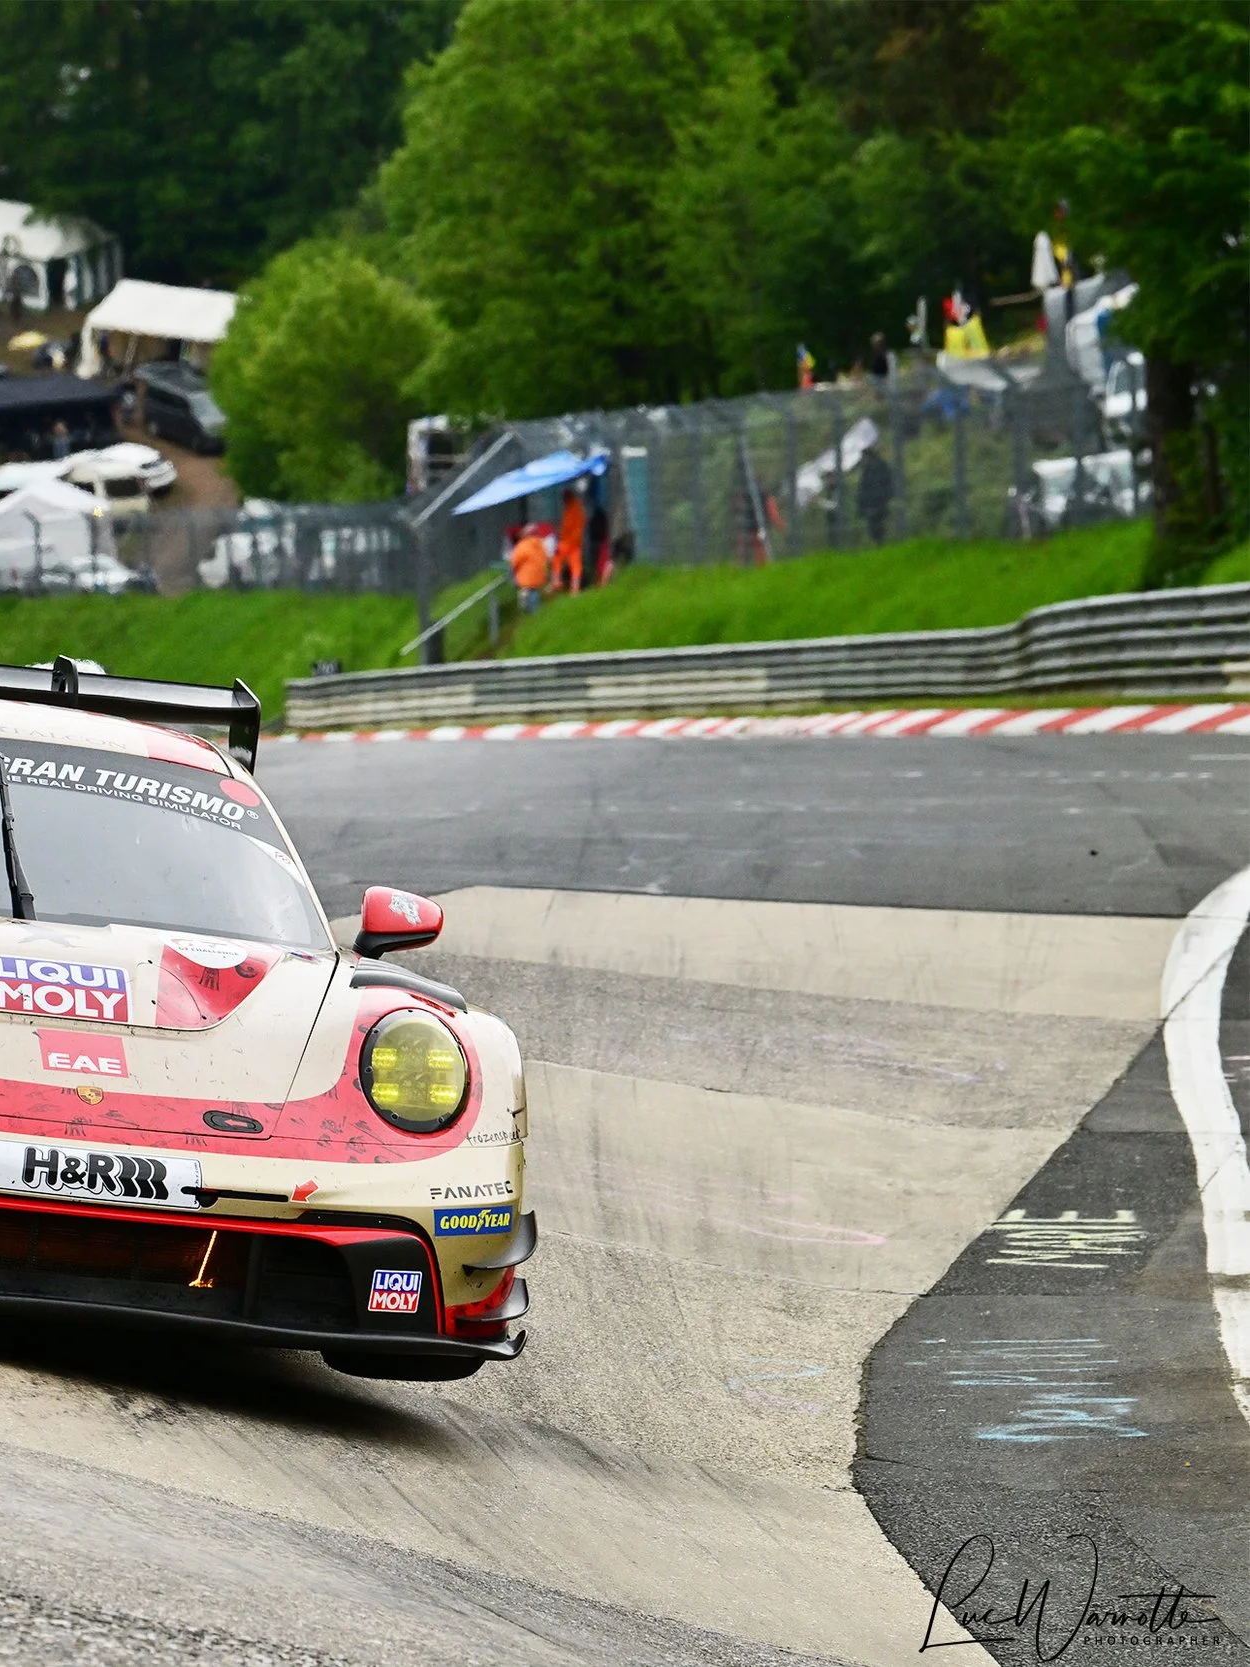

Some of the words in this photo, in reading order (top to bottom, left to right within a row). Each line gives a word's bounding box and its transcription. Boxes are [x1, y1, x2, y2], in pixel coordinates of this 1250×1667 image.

[23, 777, 70, 790] REAL
[74, 784, 143, 802] DRIVING
[148, 799, 242, 831] SIMULATOR
[47, 1052, 122, 1075] EAE
[430, 1180, 514, 1200] FANATEC
[375, 1273, 419, 1292] LIQUI
[371, 1291, 418, 1310] MOLY
